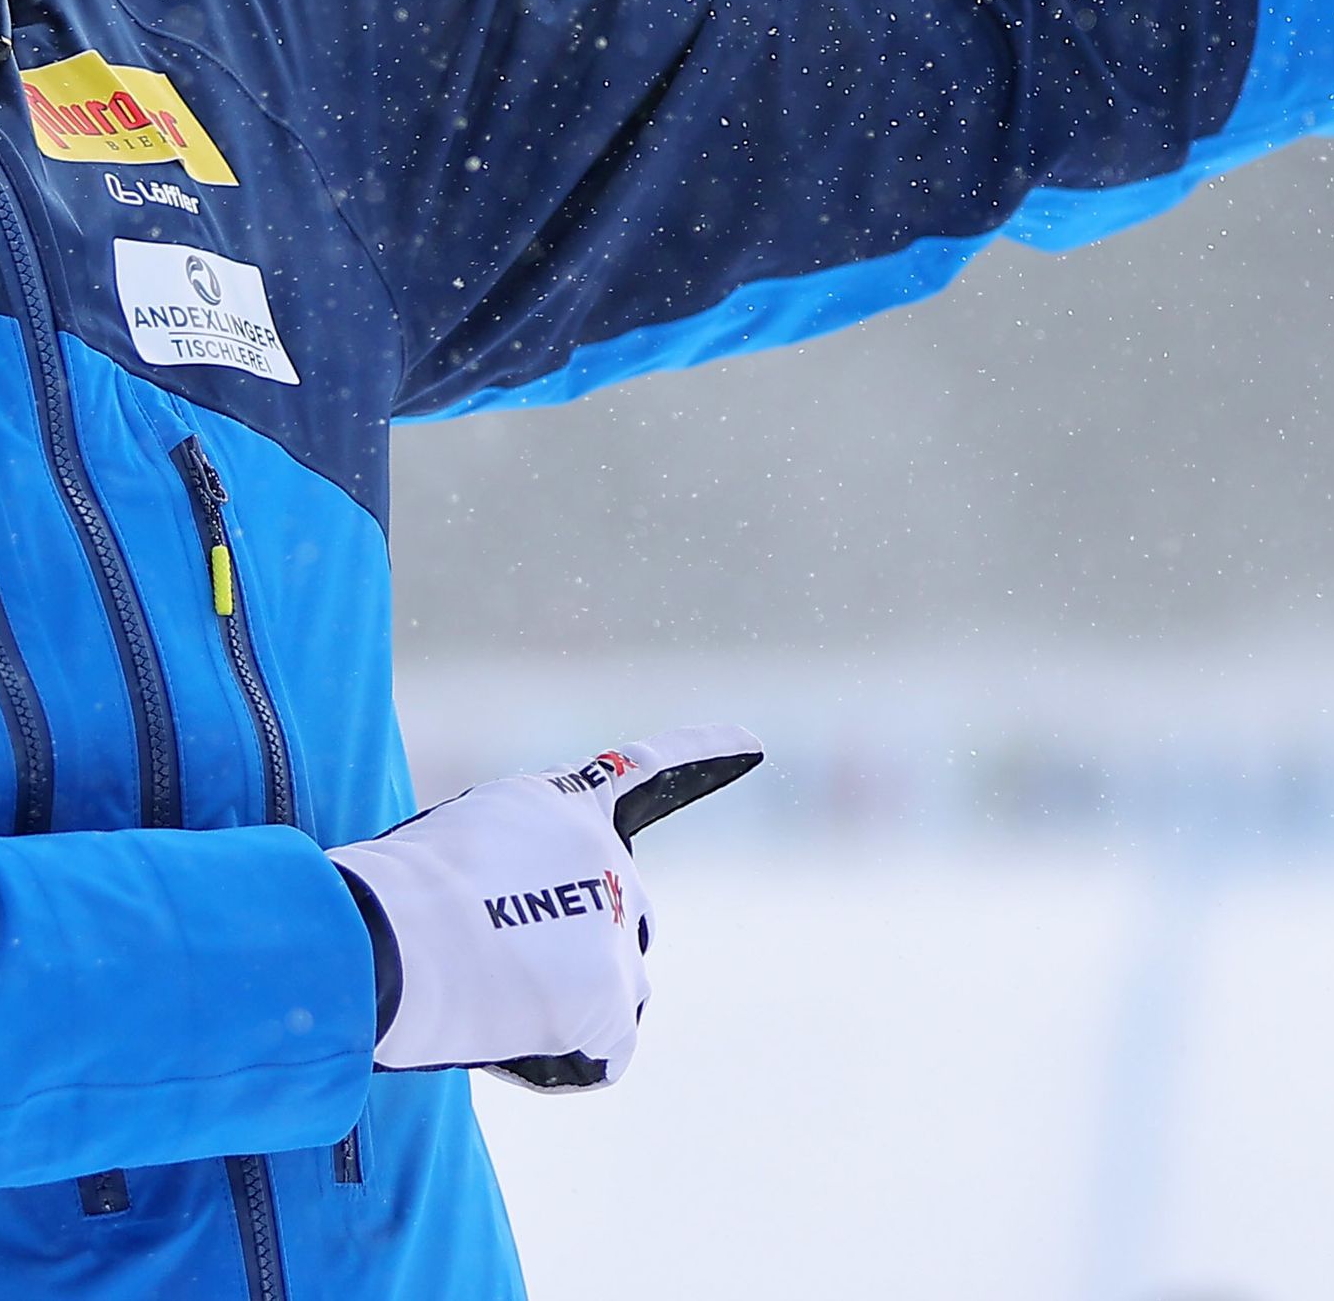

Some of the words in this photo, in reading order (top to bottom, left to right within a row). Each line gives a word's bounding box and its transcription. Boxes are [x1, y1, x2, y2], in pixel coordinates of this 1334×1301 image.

[136, 181, 199, 214] Löffler
[134, 306, 281, 351] ANDEXLINGER
[171, 339, 273, 374] TISCHLEREI
